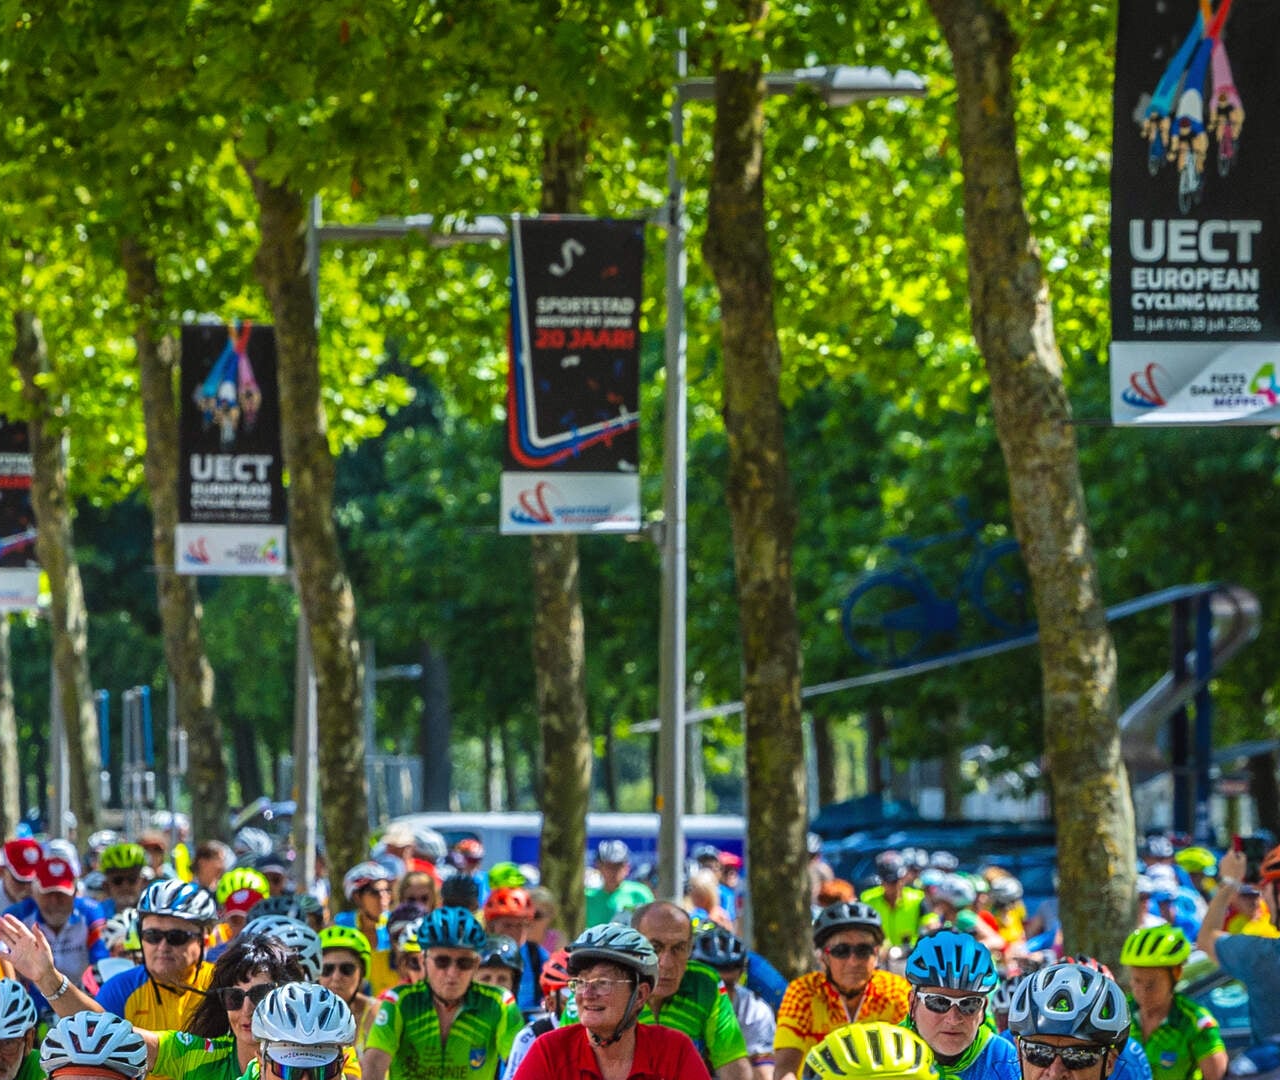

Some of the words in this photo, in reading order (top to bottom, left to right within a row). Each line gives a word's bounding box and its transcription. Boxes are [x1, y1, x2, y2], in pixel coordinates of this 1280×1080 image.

[1129, 219, 1263, 263] UECT
[1131, 267, 1260, 290] EUROPEAN
[535, 297, 635, 315] SPORTSTAD
[1131, 293, 1205, 311] CYCLING
[1206, 293, 1260, 311] WEEK
[535, 329, 566, 349] 20
[190, 453, 273, 482] UECT
